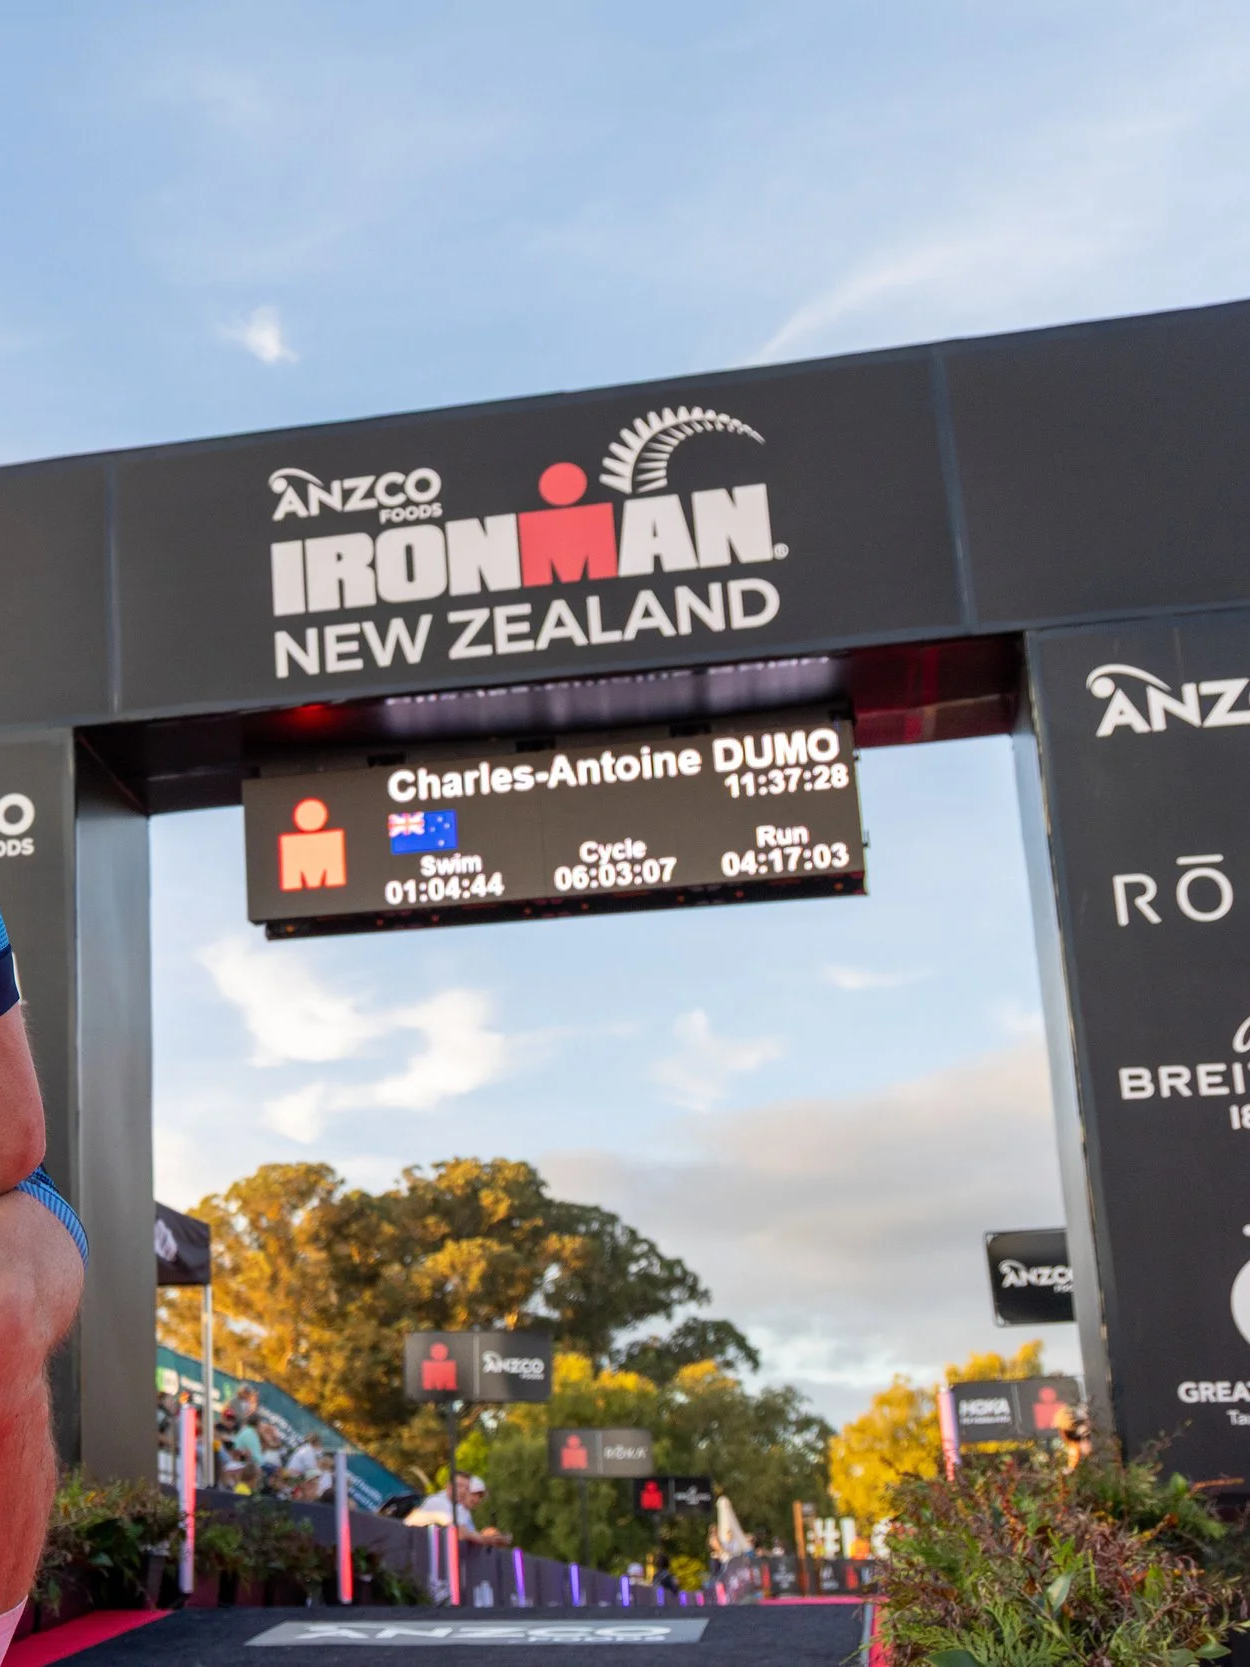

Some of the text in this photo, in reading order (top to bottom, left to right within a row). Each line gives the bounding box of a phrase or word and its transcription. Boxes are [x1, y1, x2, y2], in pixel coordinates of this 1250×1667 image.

[268, 468, 442, 521] ANZCO
[379, 502, 443, 525] FOODS
[274, 577, 781, 679] NEW ZEALAND
[1086, 664, 1250, 737] ANZ
[387, 728, 840, 803] Charles-Antoine DUMO
[724, 762, 849, 798] 11:37:28
[578, 837, 648, 865] Cycle
[755, 824, 810, 849] Run
[419, 852, 483, 876] Swim
[553, 856, 678, 892] 06:03:07
[721, 842, 850, 878] 04:17:03
[385, 871, 505, 905] 01:04:44
[1118, 1062, 1250, 1100] BREI
[482, 1350, 545, 1374] ANZCO
